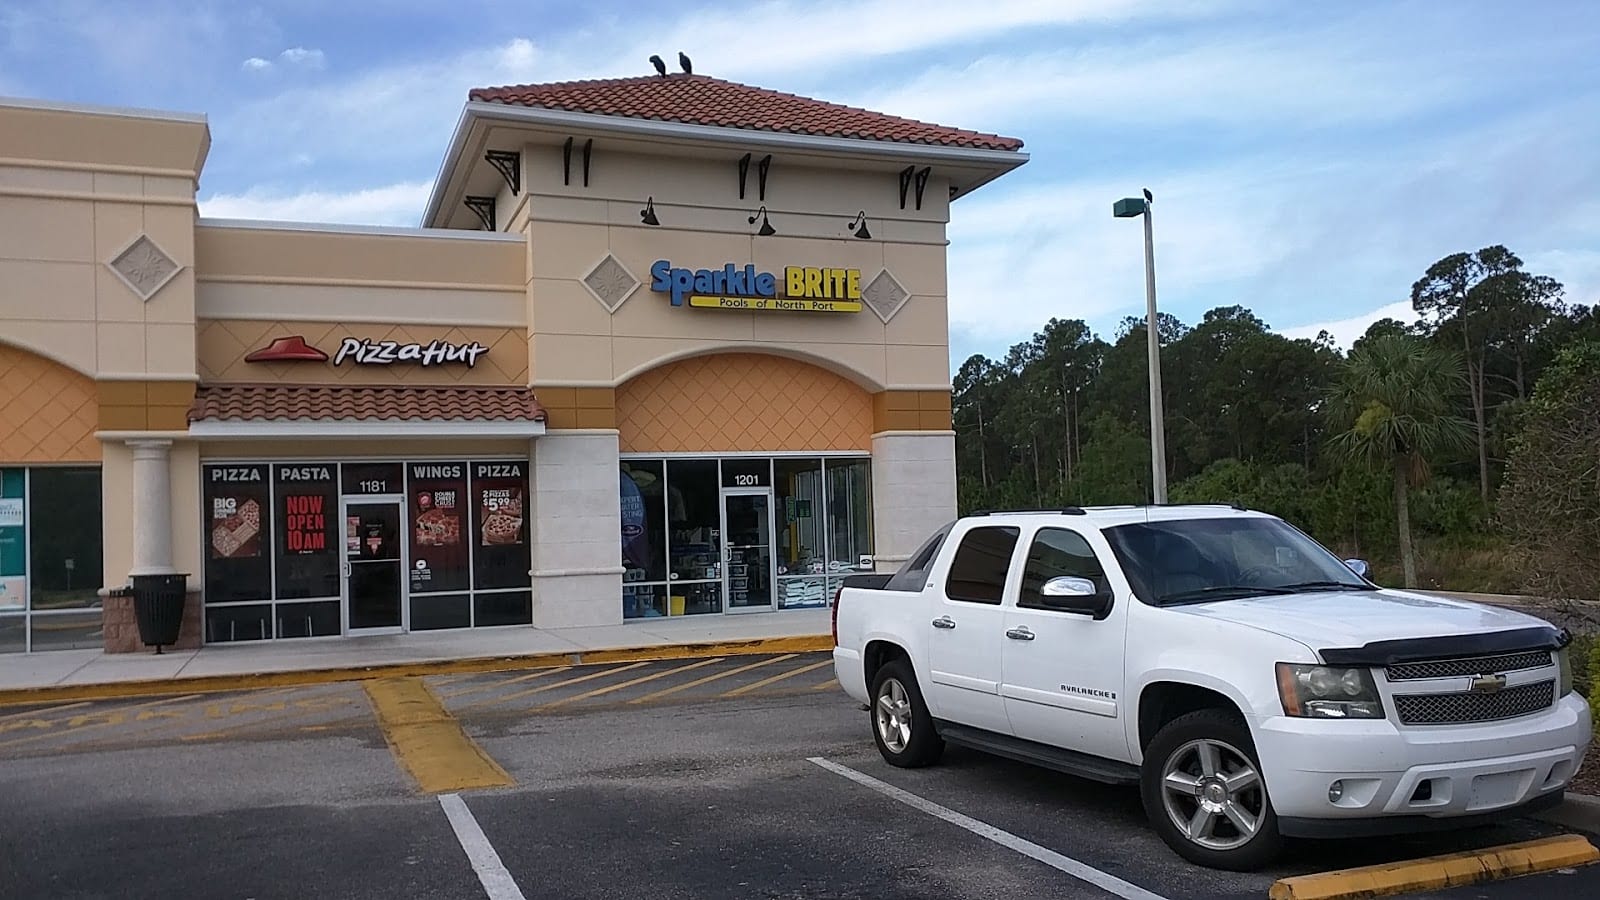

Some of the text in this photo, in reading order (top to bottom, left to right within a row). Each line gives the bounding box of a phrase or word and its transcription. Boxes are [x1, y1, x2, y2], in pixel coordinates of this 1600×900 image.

[651, 260, 861, 306] Sparkle BRITE
[719, 298, 834, 311] Pools of North Port
[334, 338, 420, 365] Pizza
[212, 468, 261, 481] PIZZA
[281, 467, 330, 480] PASTA
[413, 466, 461, 478] WINGS
[478, 465, 521, 477] PIZZA
[360, 480, 386, 493] 1181
[734, 474, 759, 486] 1201
[214, 497, 237, 508] BIG
[286, 496, 323, 514] NOW
[287, 515, 325, 530] OPEN
[1060, 684, 1110, 698] AVALANCHE
